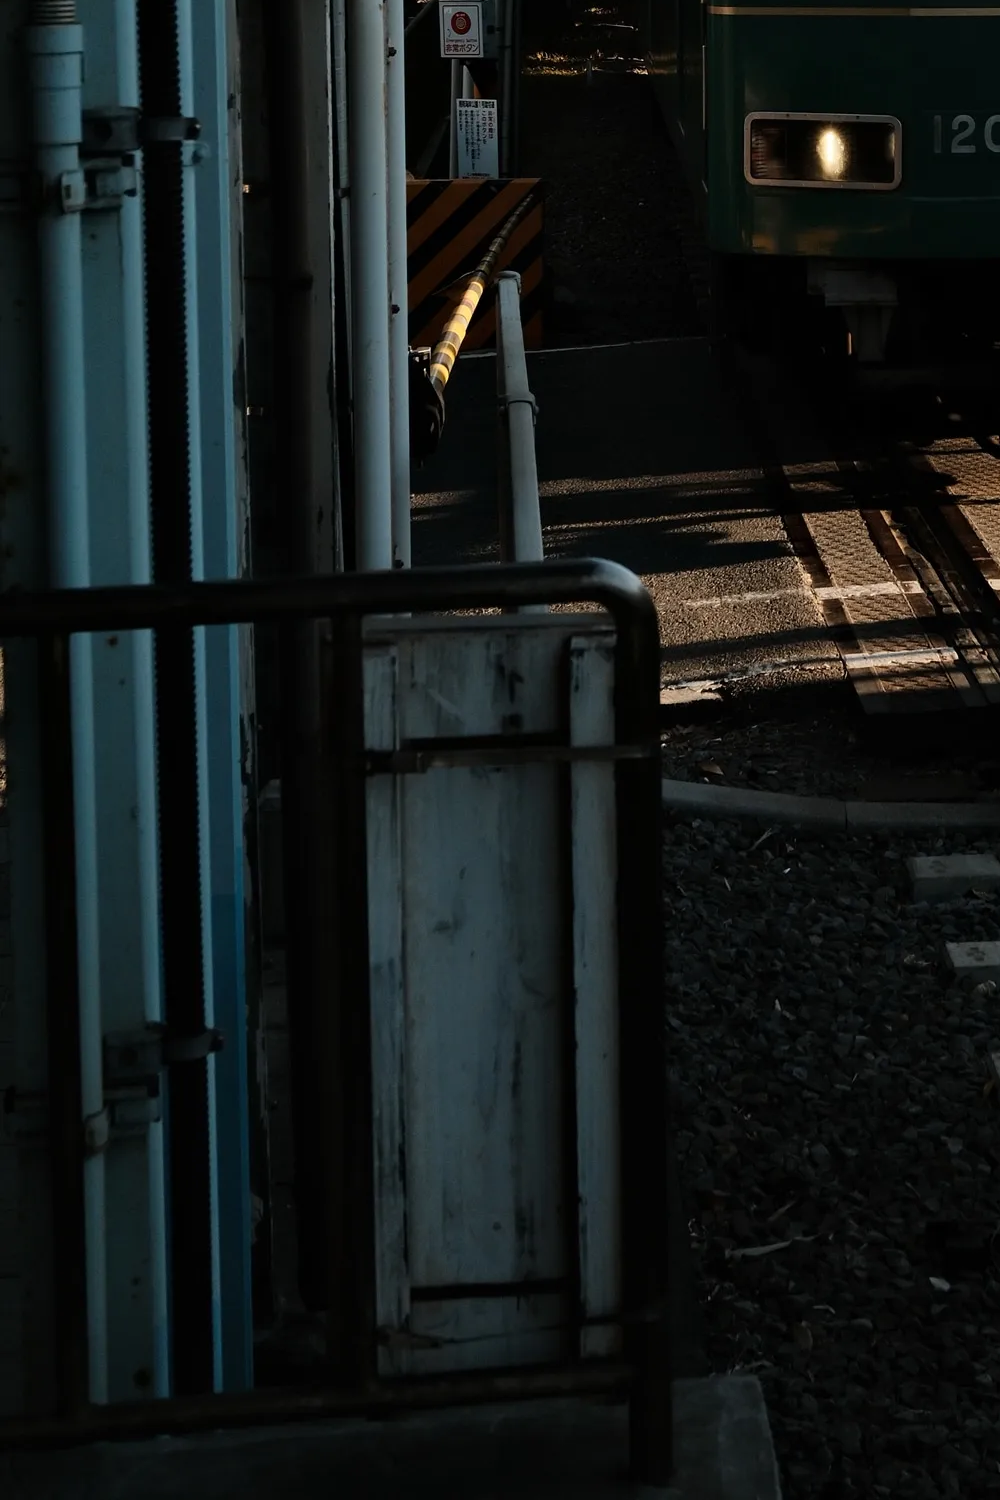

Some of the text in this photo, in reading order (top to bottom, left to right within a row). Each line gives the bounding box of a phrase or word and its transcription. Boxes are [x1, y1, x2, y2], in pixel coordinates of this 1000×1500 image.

[446, 44, 479, 53] 非常ボタン
